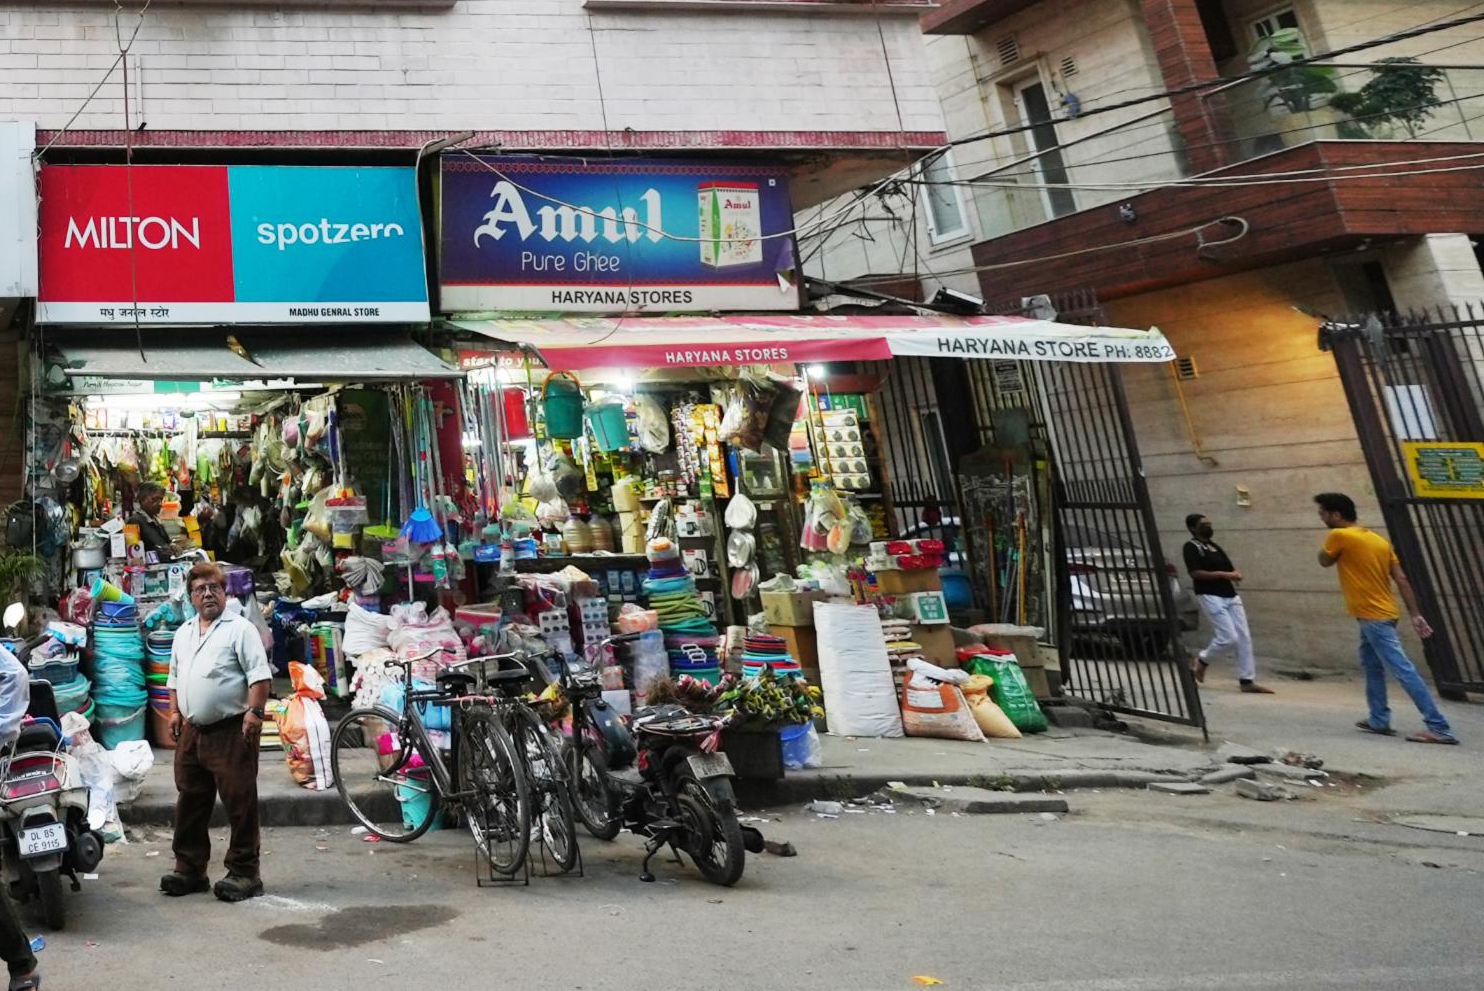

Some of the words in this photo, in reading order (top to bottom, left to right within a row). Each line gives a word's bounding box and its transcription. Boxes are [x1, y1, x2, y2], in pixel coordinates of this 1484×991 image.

[723, 199, 752, 209] Amul
[474, 180, 667, 248] Amul
[64, 216, 200, 249] MILTON
[521, 252, 565, 271] Pure
[574, 252, 620, 271] Ghee
[552, 290, 626, 304] HARYANA
[631, 290, 692, 304] STORES
[289, 307, 319, 317] MADHU
[321, 307, 352, 317] GENRAL
[354, 307, 380, 317] STORE
[937, 337, 1031, 356] HARYANA
[1035, 340, 1100, 358] STORE
[1104, 344, 1131, 359] PH:
[500, 356, 513, 365] to
[666, 350, 730, 363] HARYANA
[735, 348, 788, 360] STORES
[31, 831, 42, 841] DL
[41, 839, 60, 850] 9115
